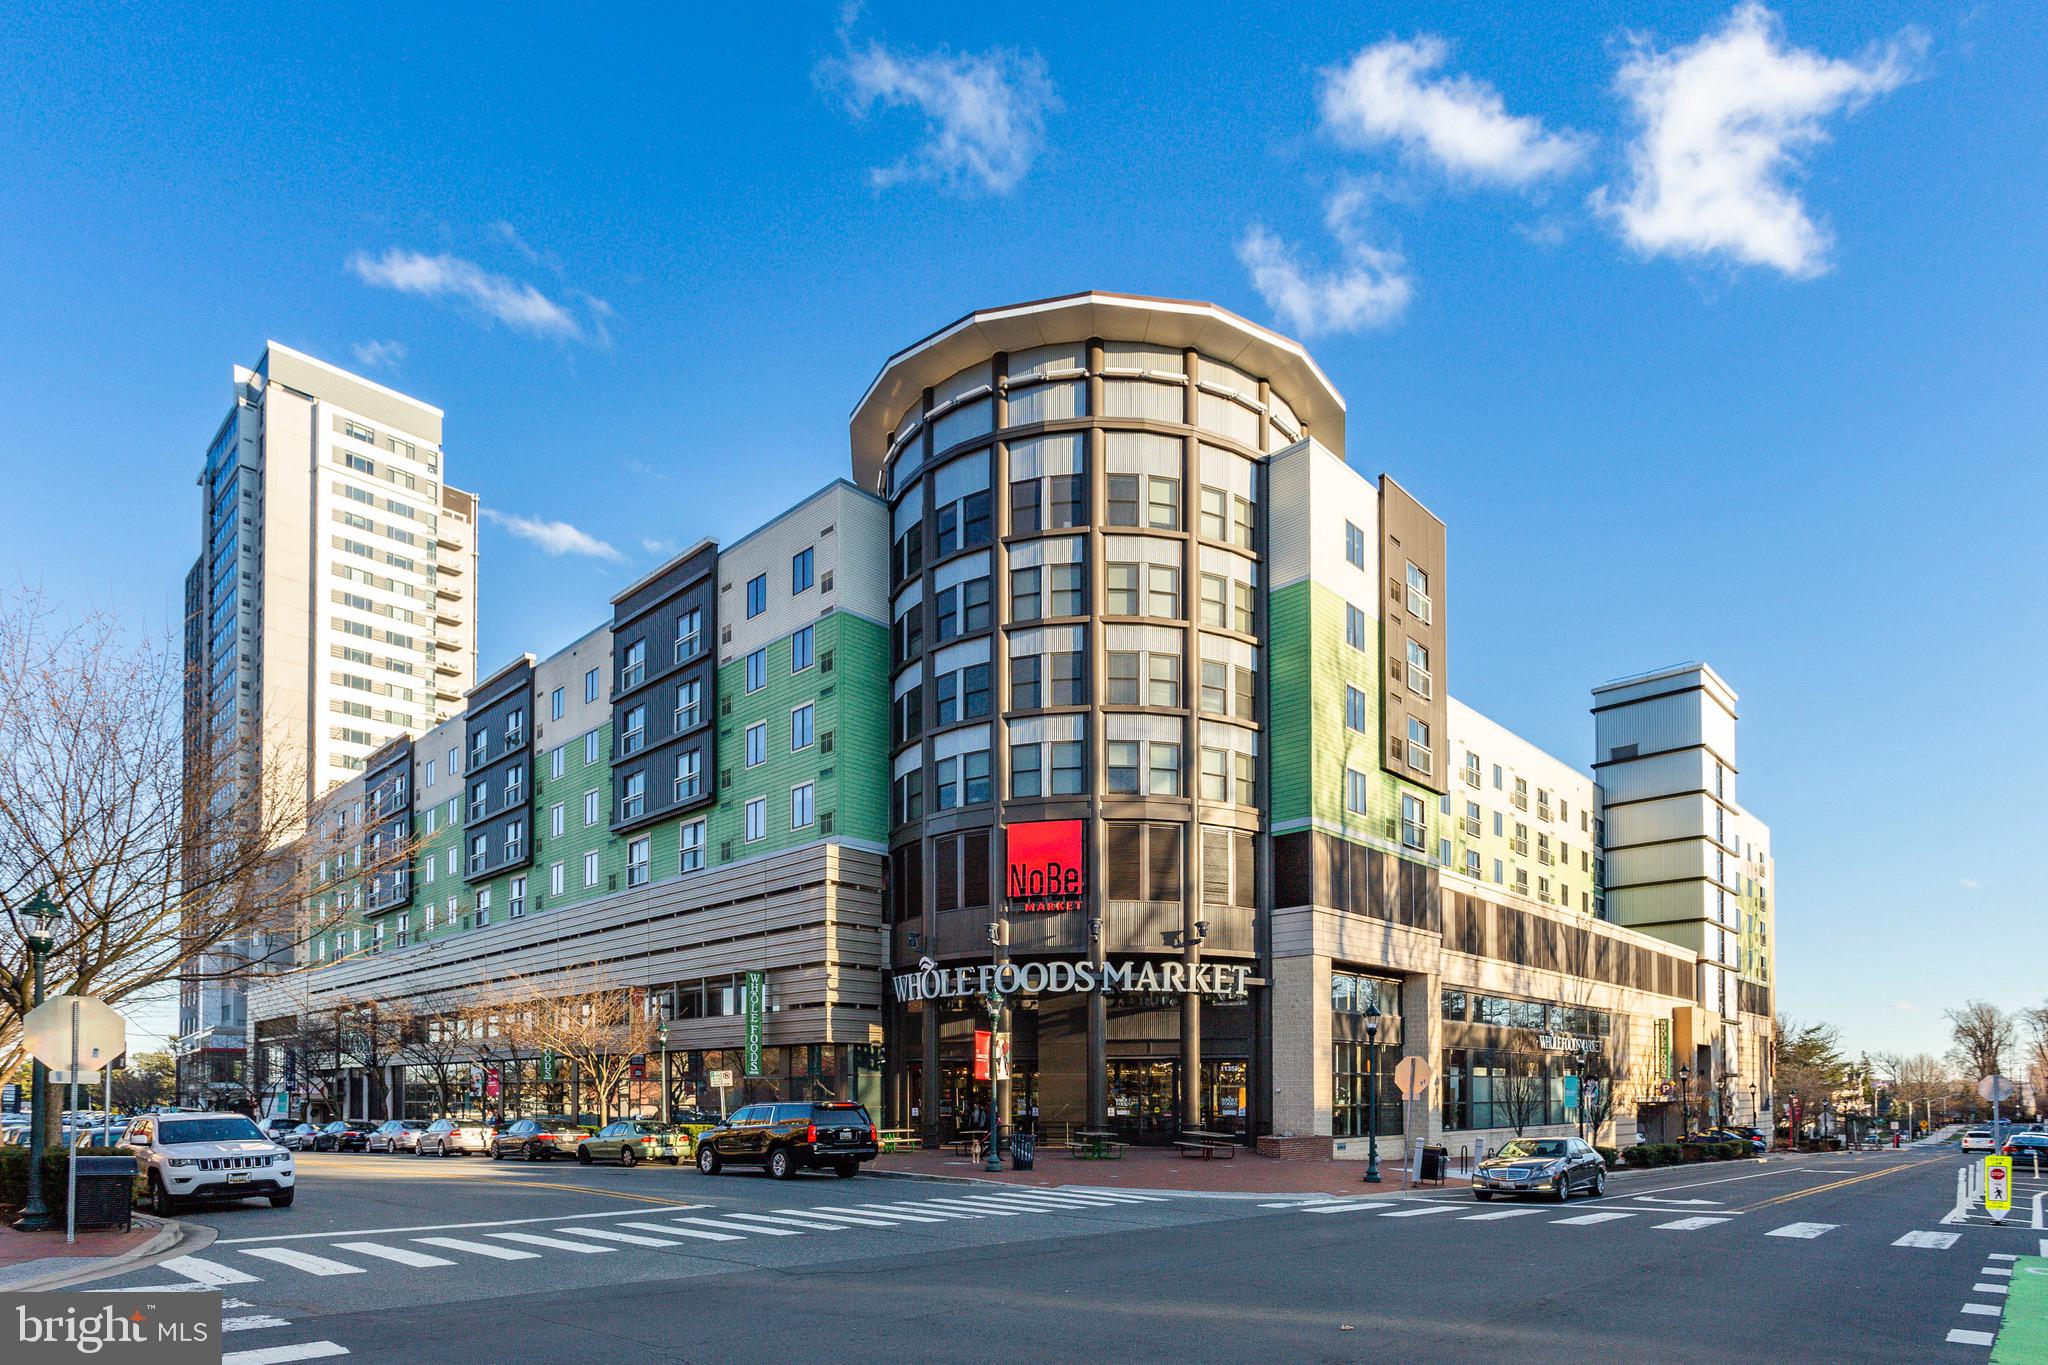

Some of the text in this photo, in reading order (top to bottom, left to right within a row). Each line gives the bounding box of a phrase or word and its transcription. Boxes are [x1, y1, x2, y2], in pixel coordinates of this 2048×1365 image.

[1011, 862, 1078, 896] NoBe
[1025, 901, 1082, 912] MARKET
[893, 956, 1251, 1002] WHOLE FOODS MARKET
[750, 973, 760, 1023] WHOLE
[750, 1025, 759, 1071] FOODS
[1539, 1030, 1562, 1050] WHOLE
[544, 1048, 552, 1077] OODS
[1662, 1085, 1670, 1093] P
